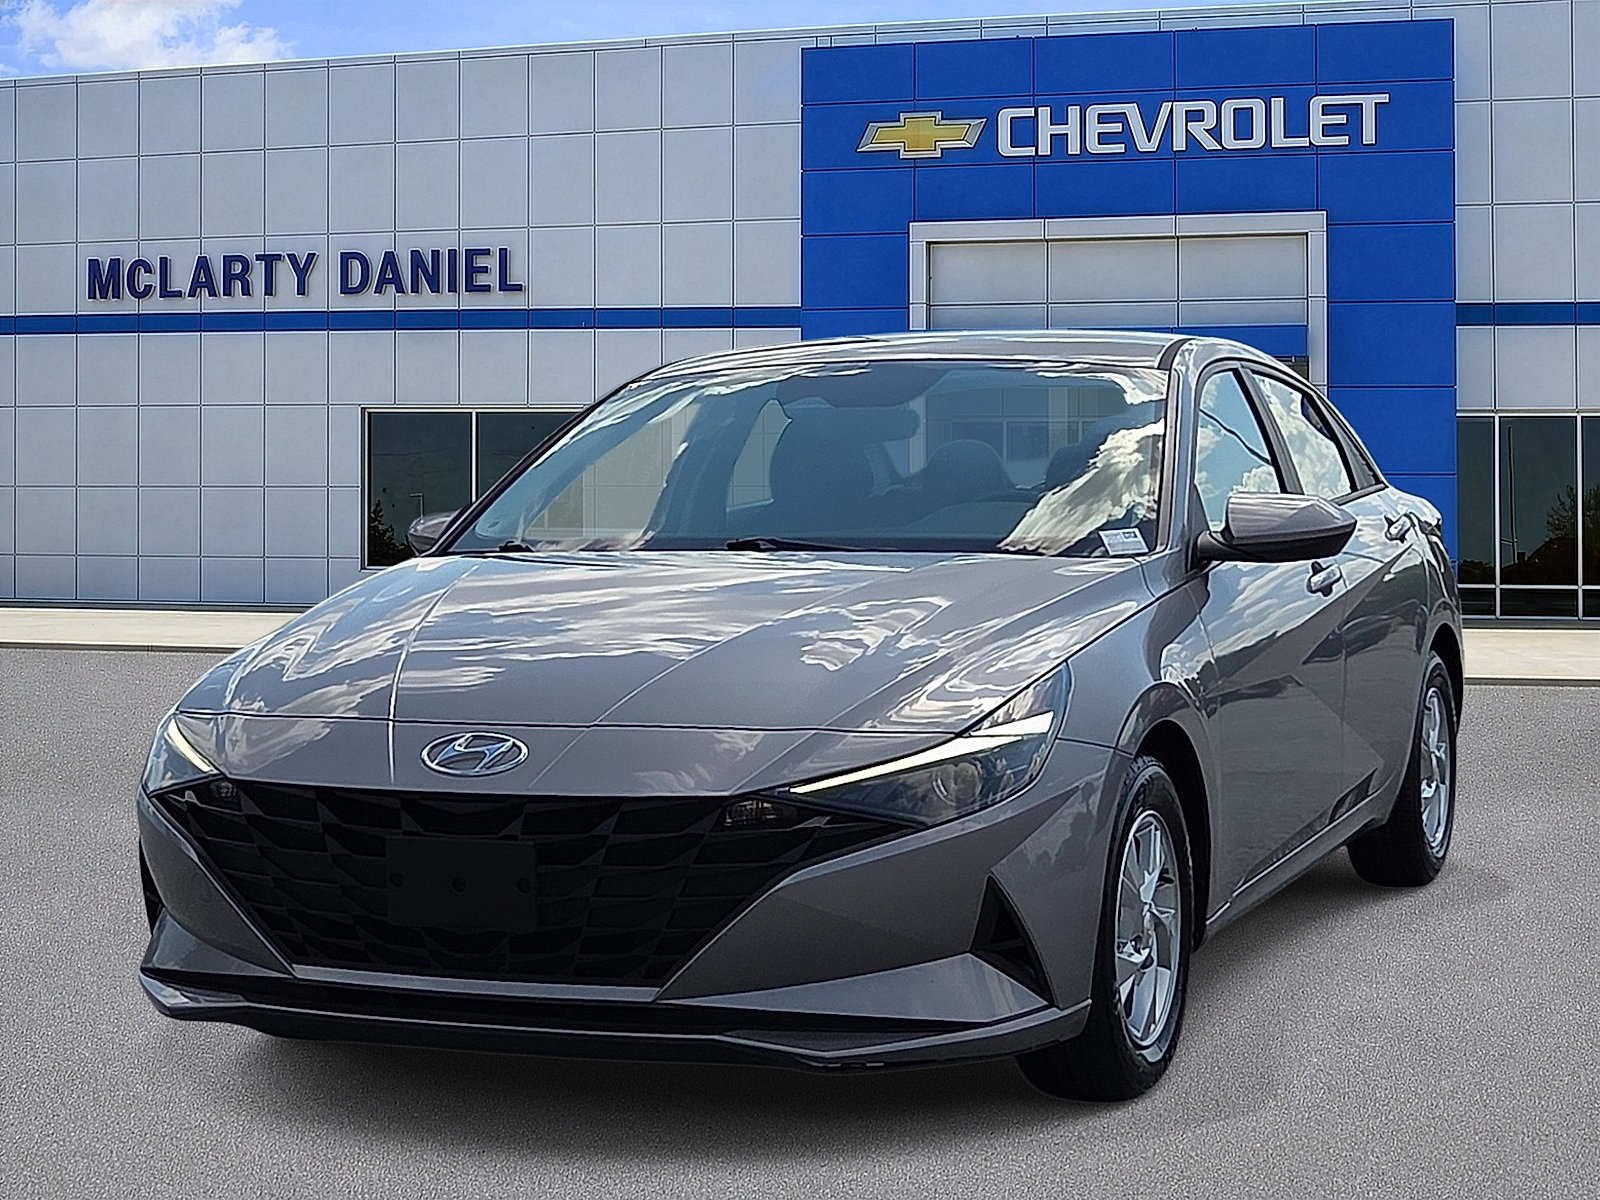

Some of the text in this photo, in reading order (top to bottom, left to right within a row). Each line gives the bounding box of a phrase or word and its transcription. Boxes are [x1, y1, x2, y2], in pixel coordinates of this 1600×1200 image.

[996, 93, 1391, 158] CHEVROLET
[86, 246, 525, 301] MCLARTY DANIEL
